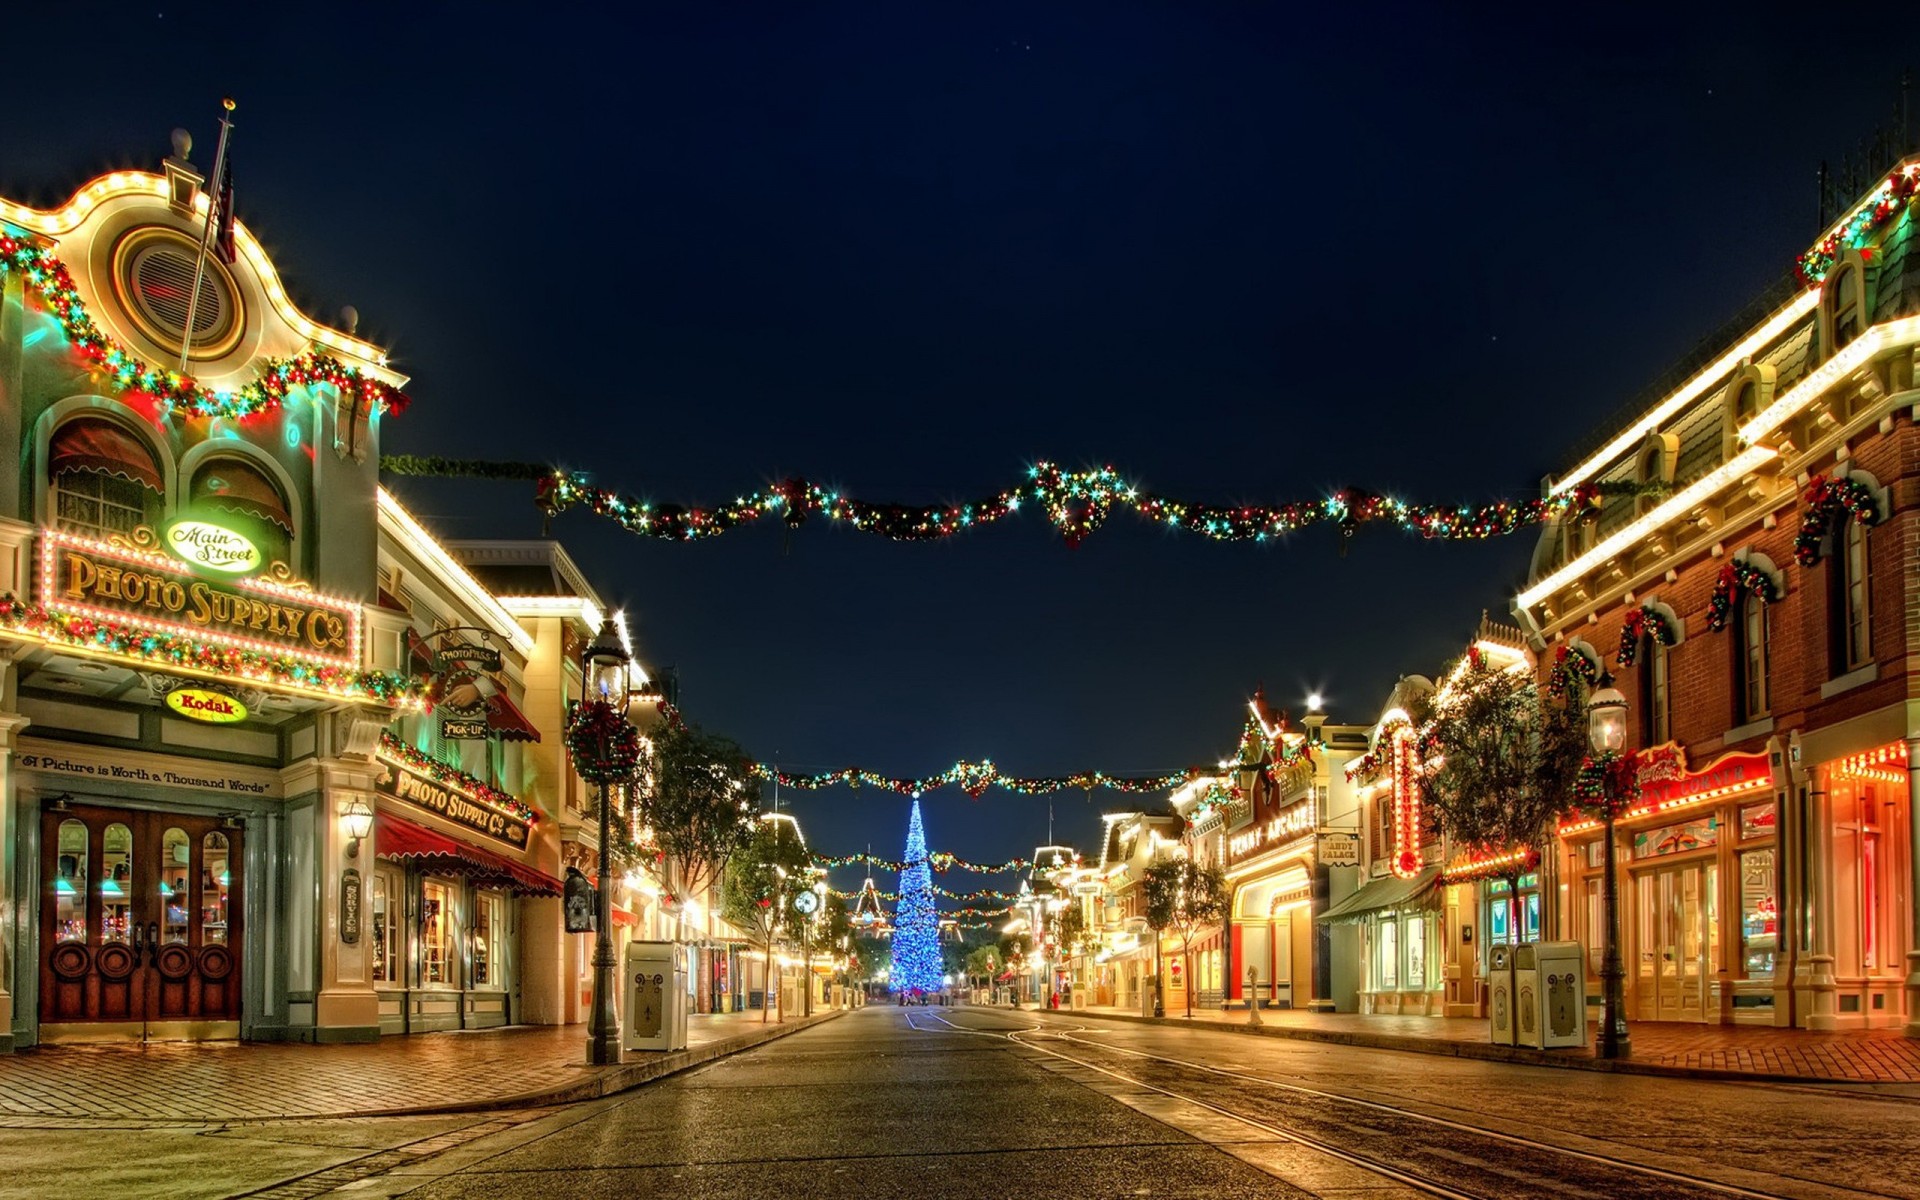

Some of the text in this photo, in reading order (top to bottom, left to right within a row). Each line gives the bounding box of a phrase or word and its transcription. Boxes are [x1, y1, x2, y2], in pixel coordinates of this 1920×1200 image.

[173, 526, 243, 547] Main
[196, 543, 254, 566] Street
[66, 552, 187, 611] PHOTO
[186, 582, 304, 637] SUPPLY
[182, 694, 234, 715] Kodak
[41, 757, 95, 774] Picture
[98, 765, 109, 776] is
[110, 765, 150, 780] Worth
[152, 773, 162, 782] a
[164, 772, 226, 789] Thousand
[396, 770, 447, 809] PHOTO
[447, 794, 490, 827] SUPPLY
